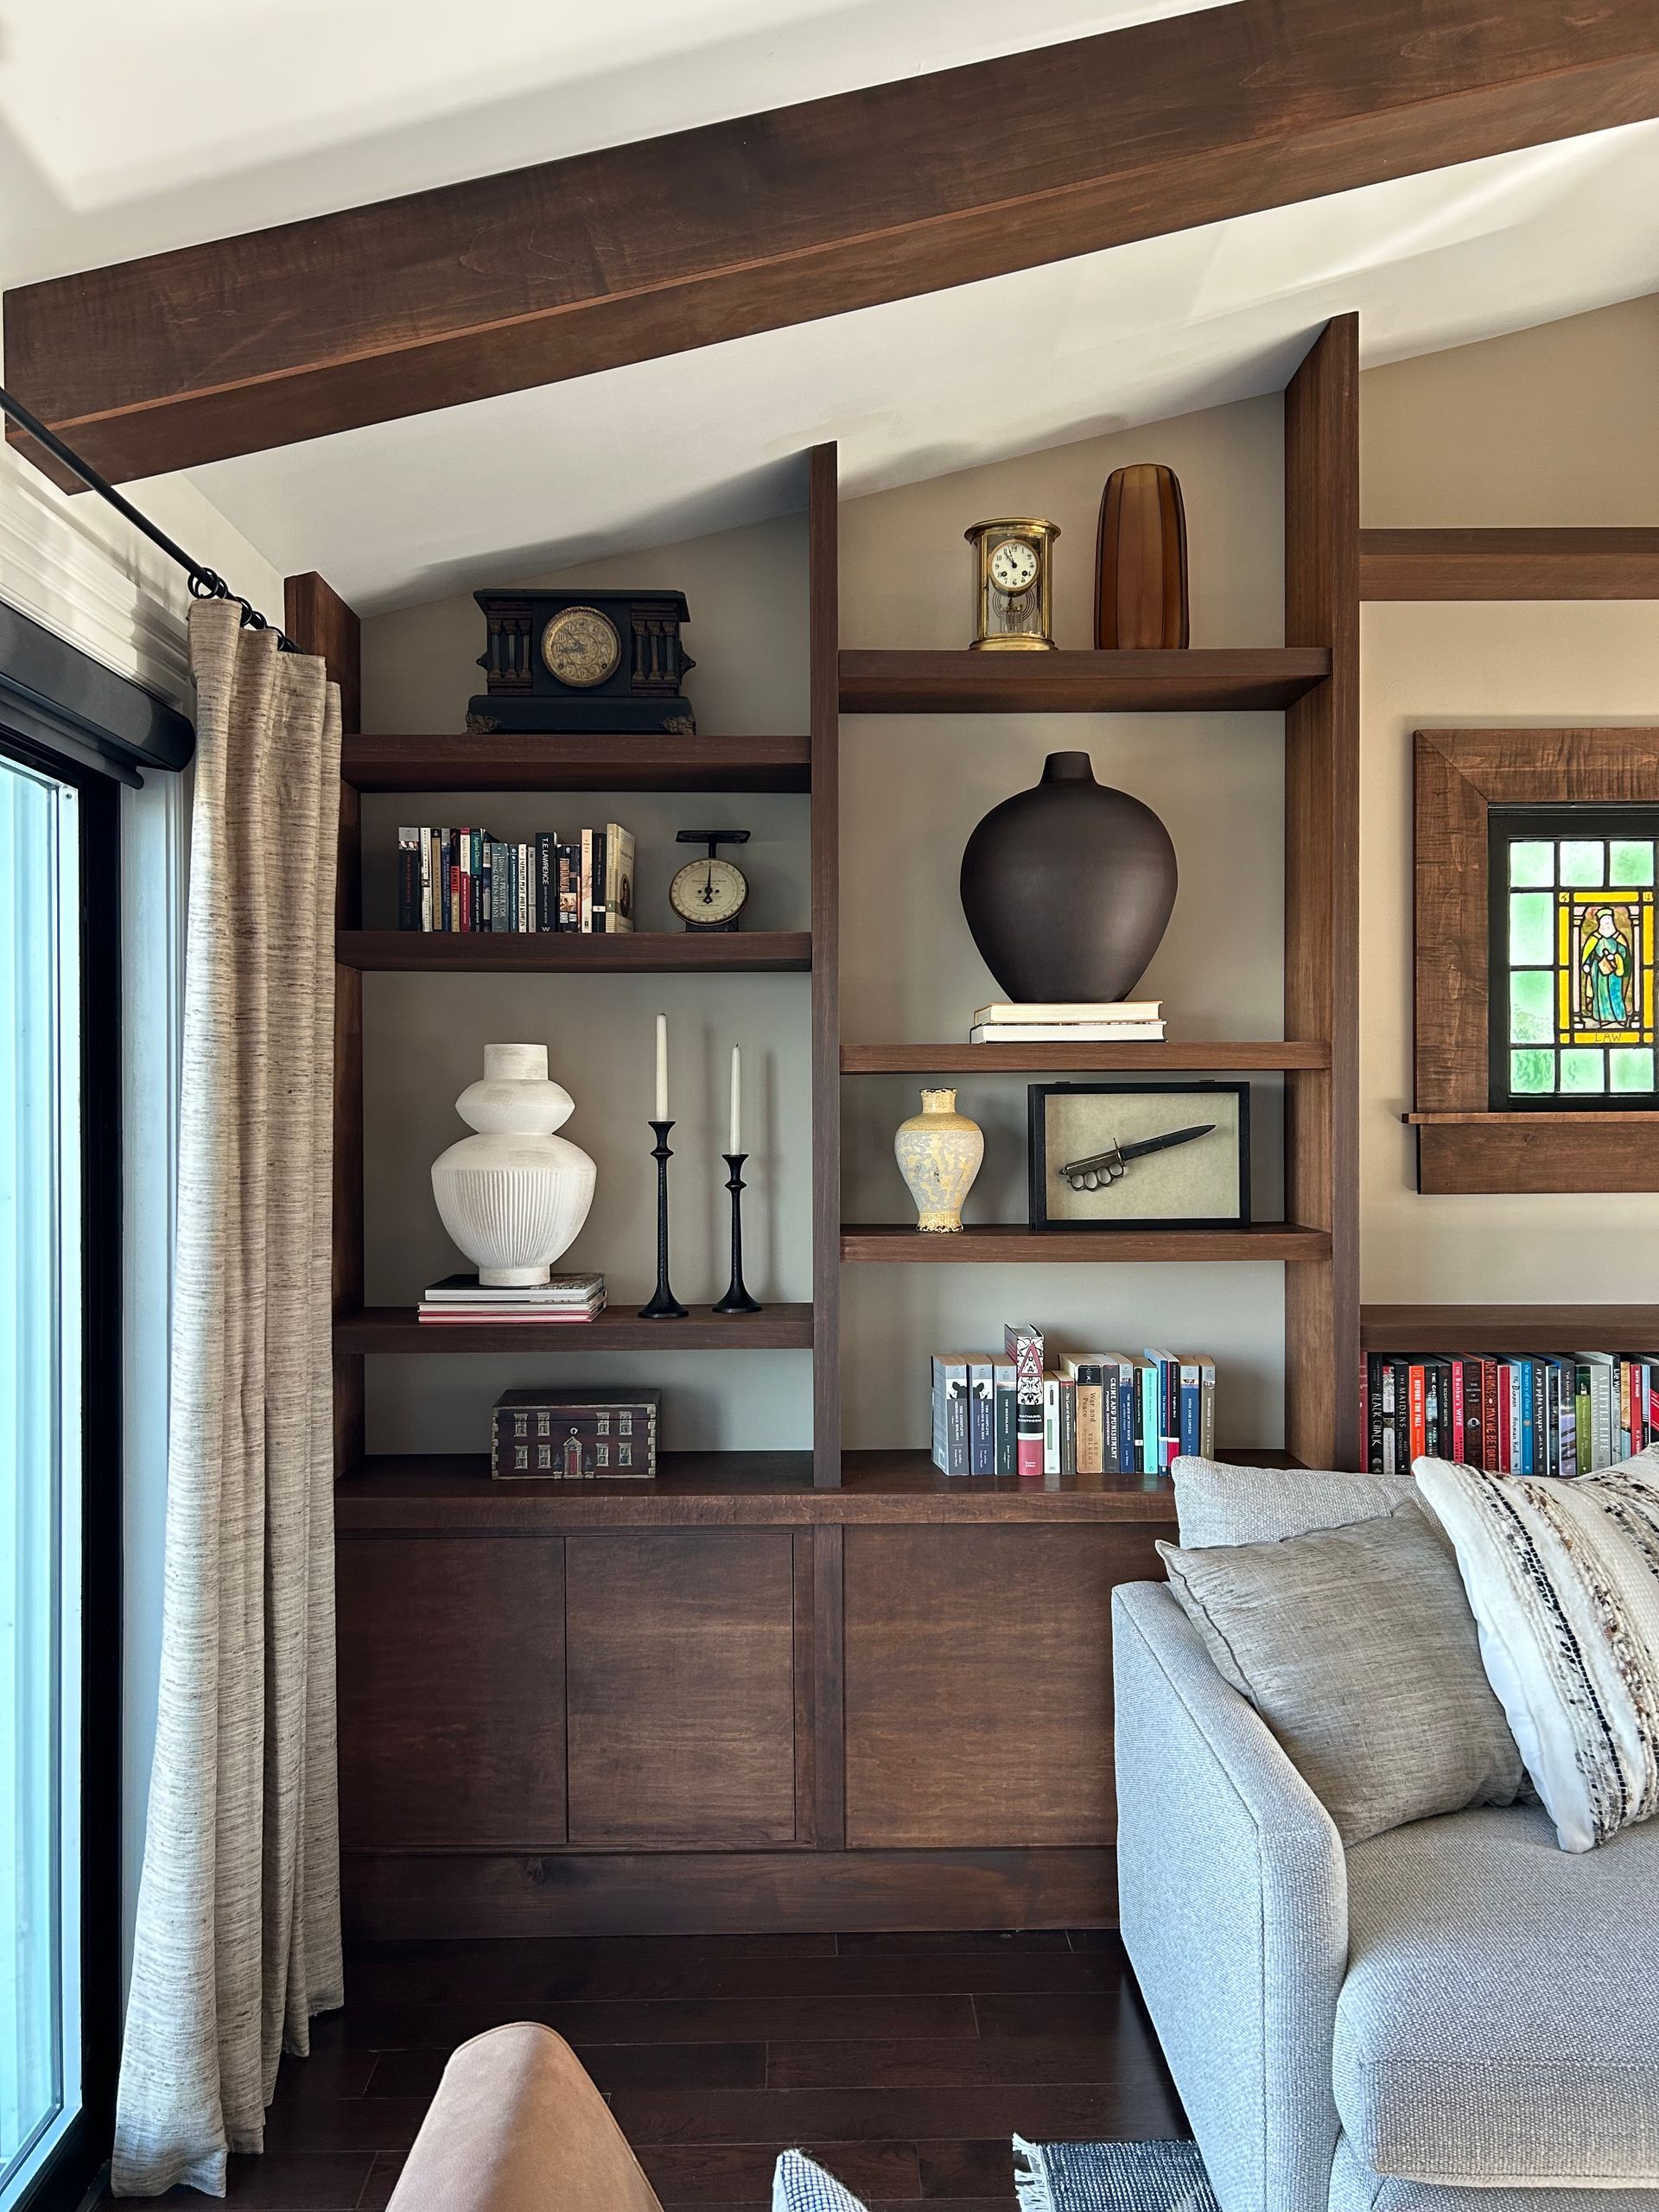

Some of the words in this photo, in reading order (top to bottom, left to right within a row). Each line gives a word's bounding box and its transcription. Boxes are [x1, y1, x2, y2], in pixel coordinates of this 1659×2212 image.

[1595, 1033, 1622, 1042] LAW
[1371, 1393, 1382, 1417] BLACK
[1398, 1387, 1407, 1427] MAIDENS
[1511, 1385, 1520, 1408] Dinner
[1599, 1384, 1609, 1422] LITTLE
[1613, 1400, 1620, 1410] Me
[1486, 1408, 1497, 1422] MAY
[1371, 1420, 1382, 1446] CHALK
[1486, 1422, 1497, 1433] WE
[1486, 1435, 1497, 1445] BE
[1599, 1429, 1609, 1452] LIFE
